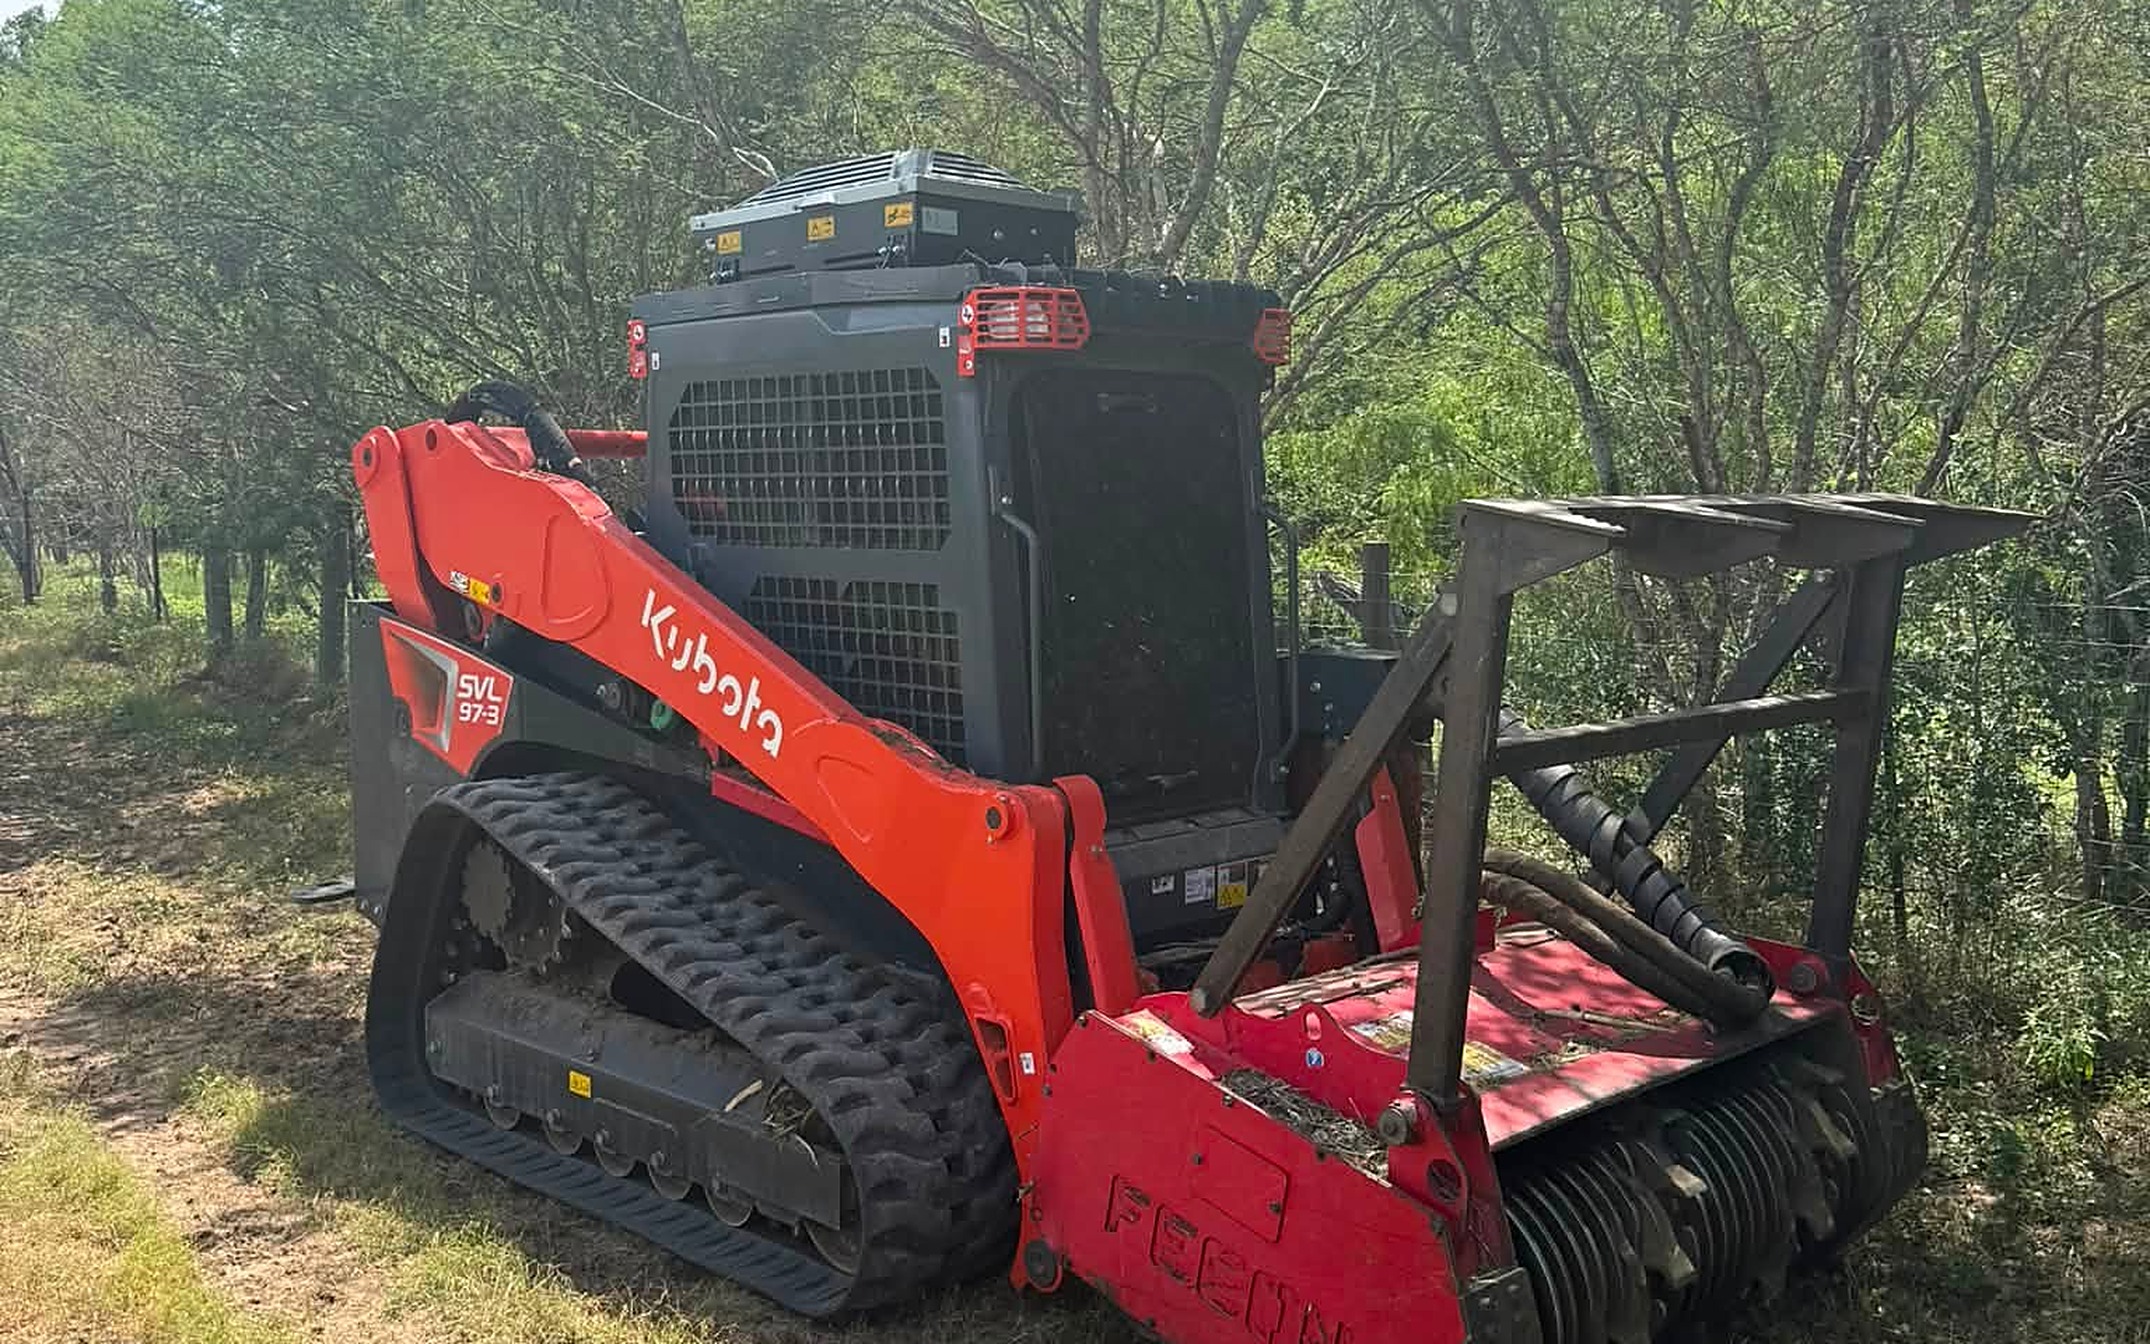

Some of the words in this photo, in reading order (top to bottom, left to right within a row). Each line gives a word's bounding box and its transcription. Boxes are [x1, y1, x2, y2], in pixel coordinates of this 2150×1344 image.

[641, 588, 783, 758] Kubota
[457, 674, 503, 703] SVL
[458, 702, 500, 726] 97-3
